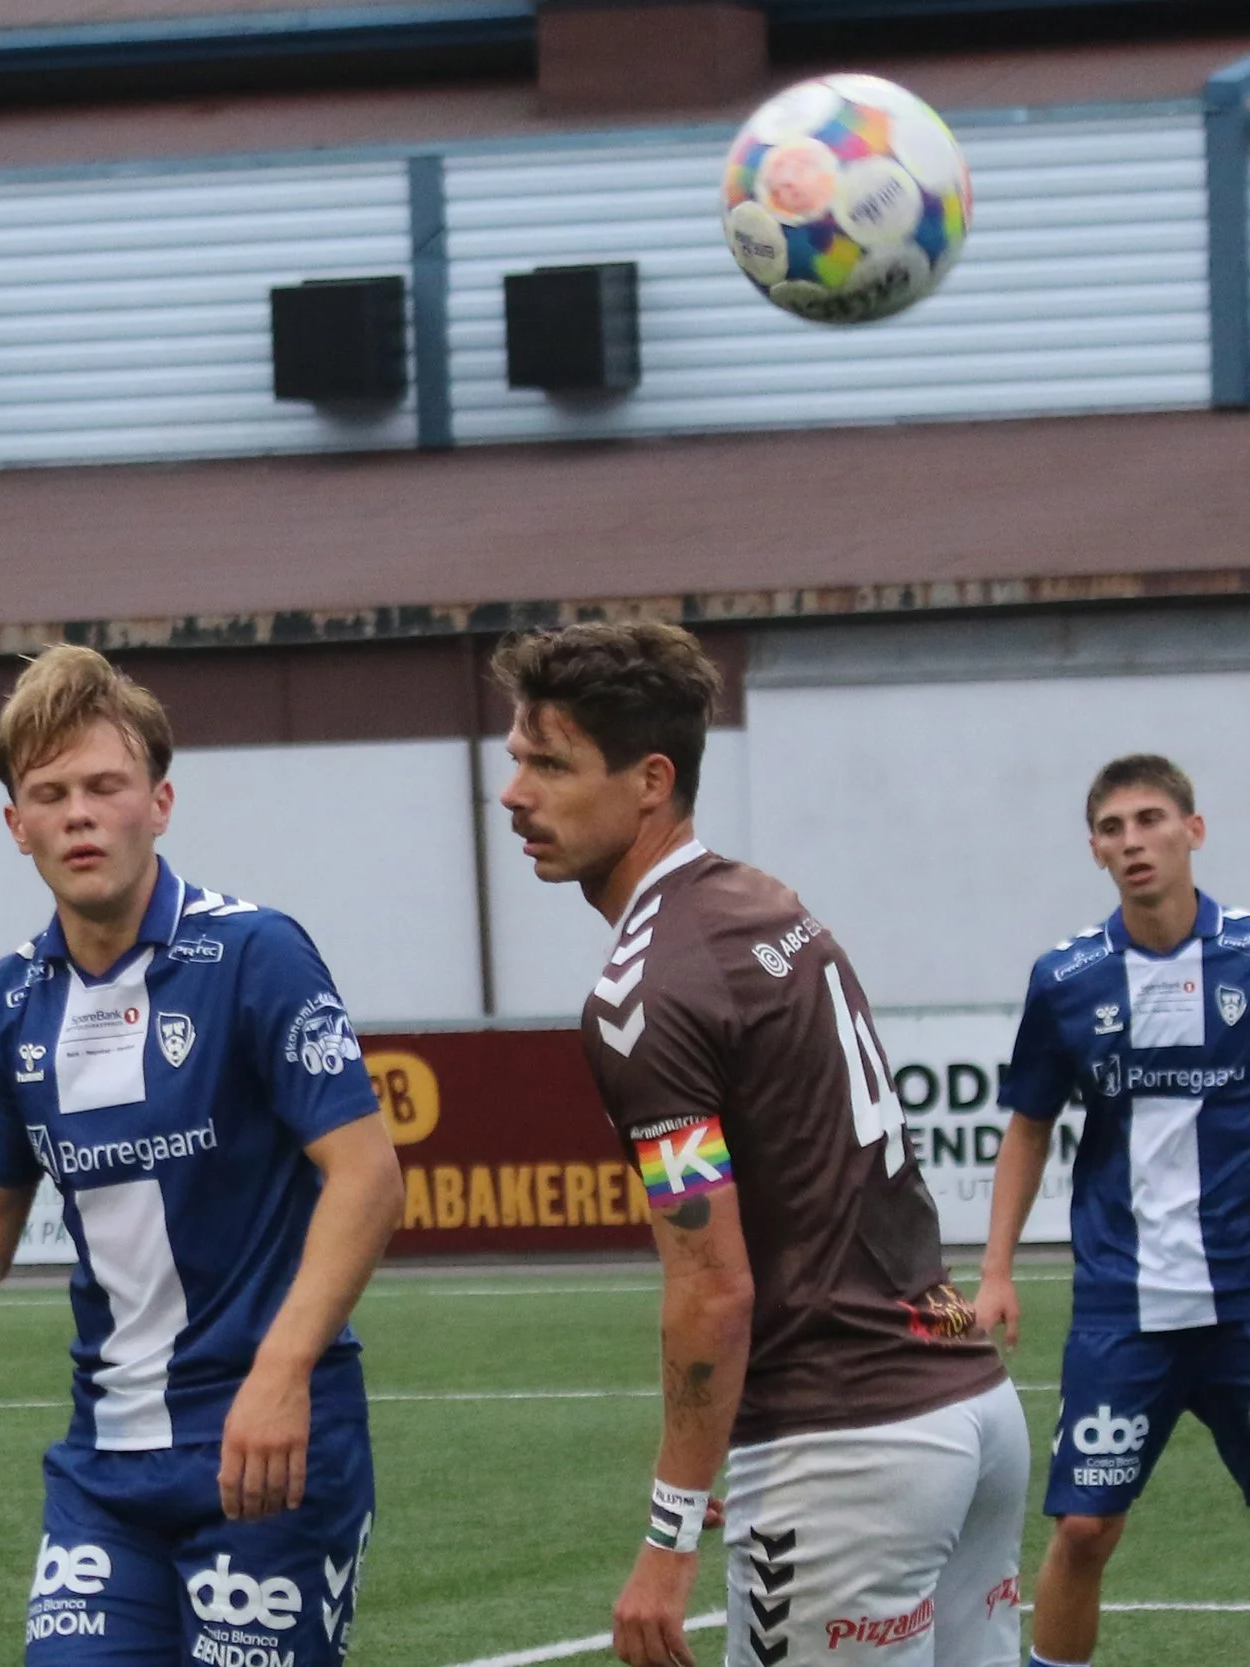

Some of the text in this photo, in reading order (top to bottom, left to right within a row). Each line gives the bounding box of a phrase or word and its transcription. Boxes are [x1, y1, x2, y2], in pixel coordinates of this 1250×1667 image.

[779, 925, 810, 957] ABC
[824, 960, 907, 1179] 4
[59, 1117, 218, 1175] Borregaard
[659, 1126, 723, 1195] K
[1073, 1466, 1141, 1487] EIENDO
[231, 1629, 279, 1648] Blanca
